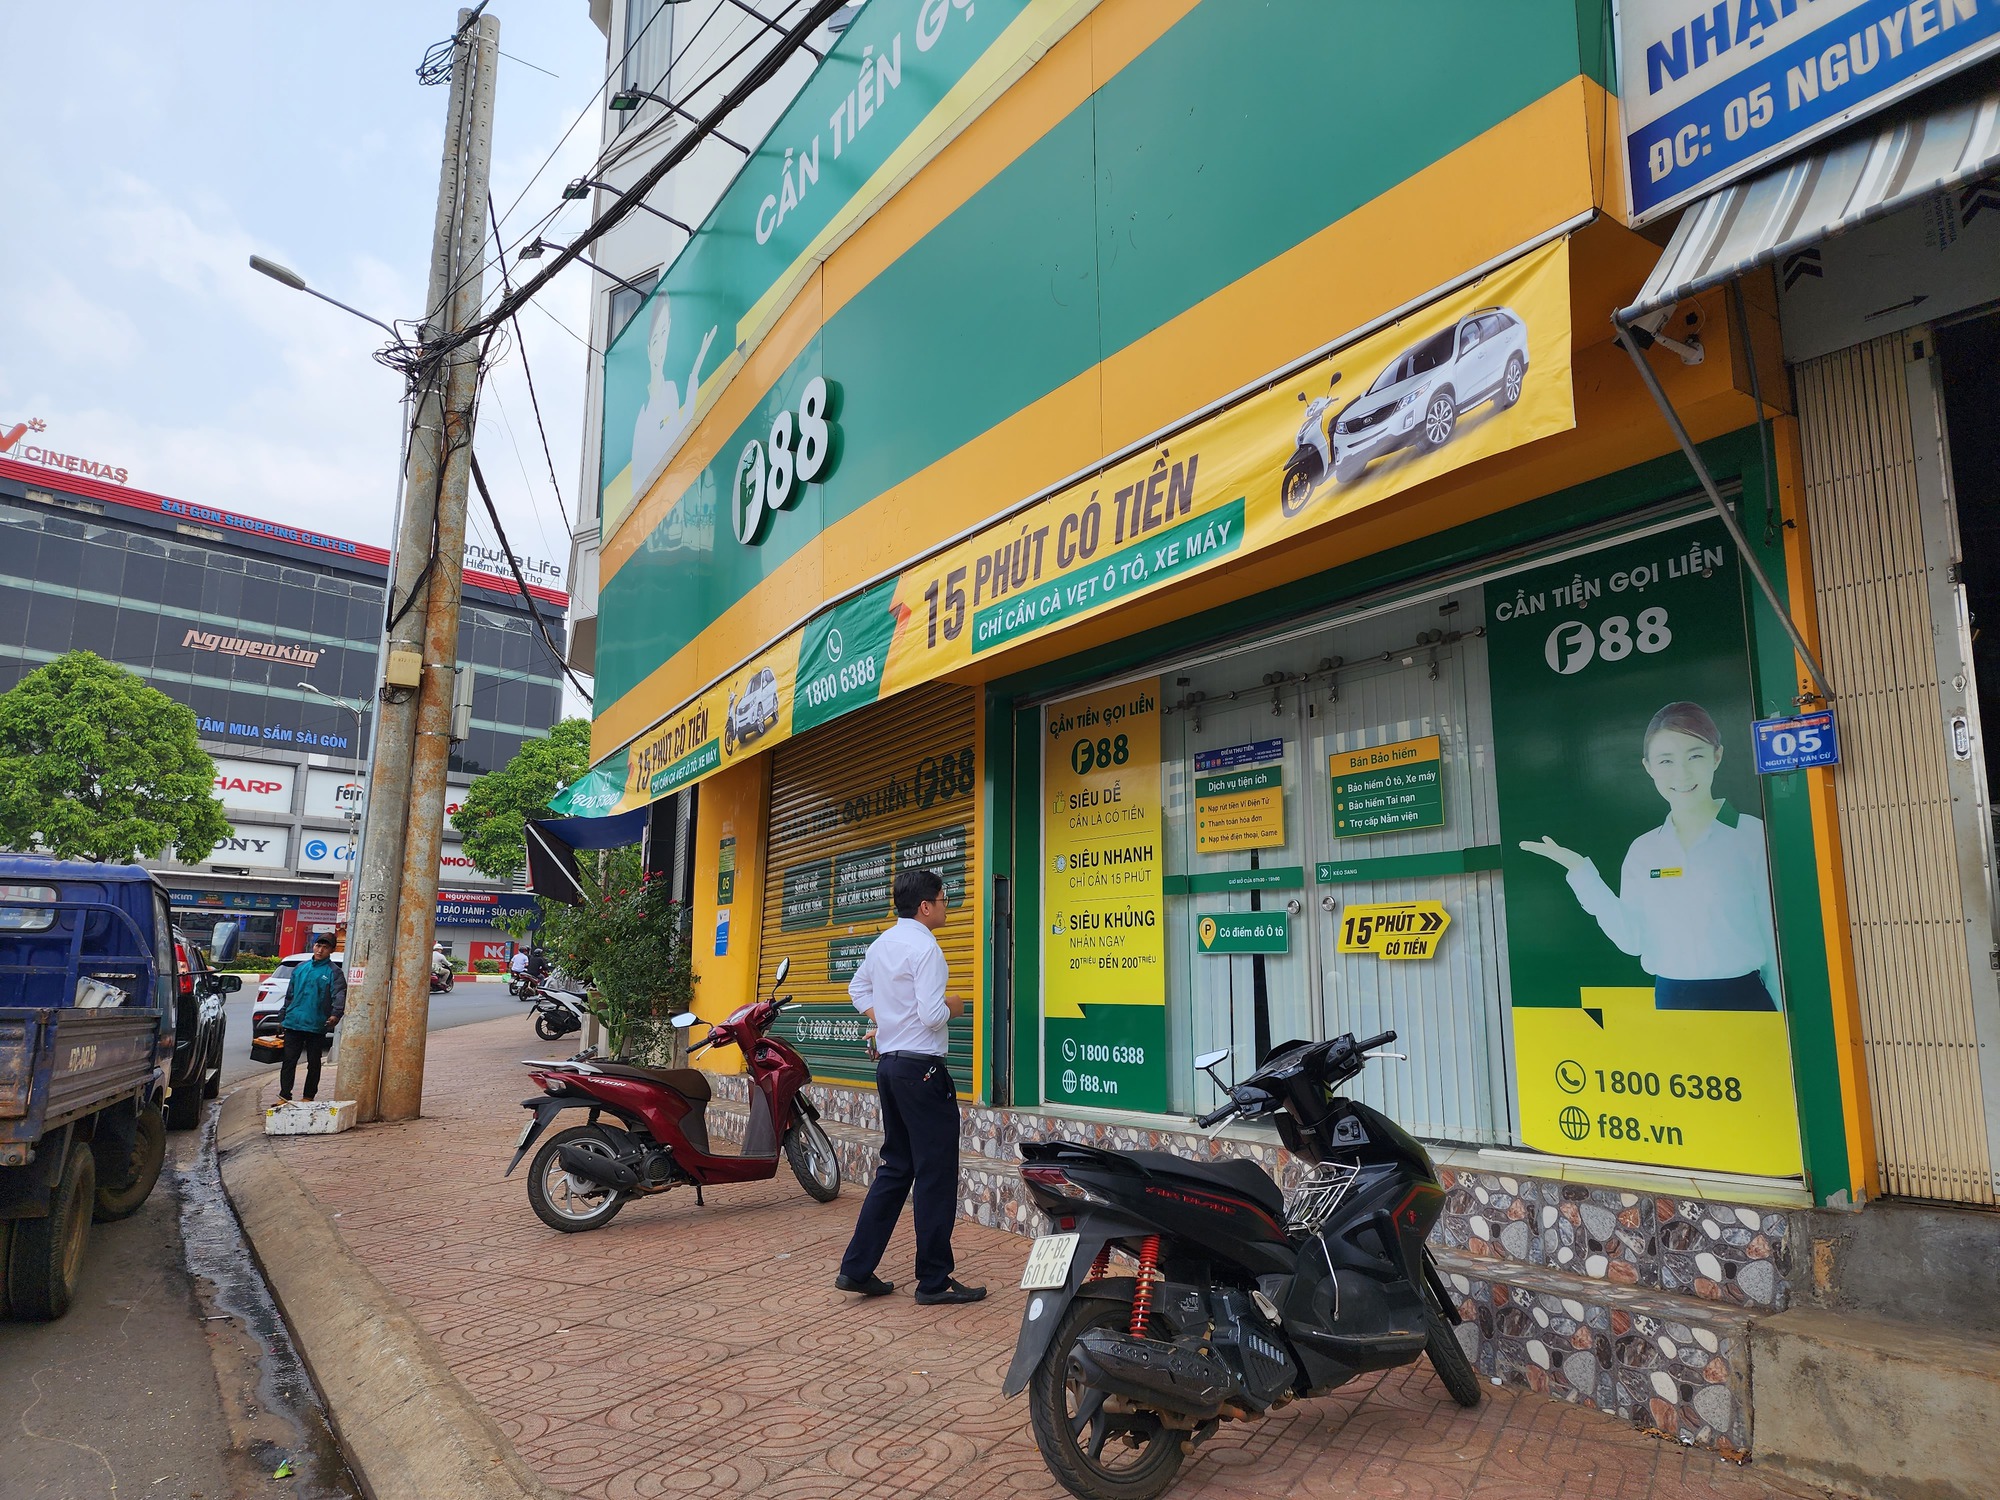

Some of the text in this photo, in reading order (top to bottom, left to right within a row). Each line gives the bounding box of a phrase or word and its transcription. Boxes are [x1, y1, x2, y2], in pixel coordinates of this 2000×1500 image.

[756, 32, 901, 245] CẦN TIỀN
[1649, 124, 1712, 184] ĐC:
[1723, 81, 1774, 141] 05
[24, 445, 129, 483] CINEMAS
[161, 499, 357, 554] SAI GON SHOPPING CENTER
[924, 565, 967, 649] 15
[973, 524, 1050, 607] PHÚT
[1056, 490, 1101, 569] CÓ
[1113, 449, 1199, 545] TIỀN
[527, 556, 561, 577] Life
[979, 520, 1232, 641] CHỈ CẦN CÀ VẸT Ô TÔ, XE MÁY
[1495, 541, 1724, 622] CẦN TIỀN GỌI LIỀN
[1544, 606, 1672, 675] F88
[806, 655, 875, 708] 1800 6388
[1050, 692, 1154, 736] CẦN TIỀN GỌI LIỀN
[229, 723, 259, 738] MUA
[263, 724, 292, 741] SẮM
[296, 729, 317, 745] SÀI
[320, 733, 347, 749] GÒN
[636, 701, 709, 793] 15 PHÚT CÓ TIỀN
[1772, 729, 1822, 756] 05
[1071, 734, 1130, 775] F88
[1350, 747, 1417, 768] Bán Bảo hiểm
[1208, 773, 1268, 792] Dịch vụ tiện ích
[1348, 770, 1436, 793] Bảo hiểm Ô tô, Xe máy
[1069, 780, 1121, 810] SIÊU DỄ
[1348, 794, 1415, 811] Bảo hiểm Tai nạn
[1069, 803, 1145, 829] CẦN LÀ CÓ TIỀN
[1207, 805, 1218, 814] Nạp
[1350, 811, 1418, 829] Trợ cấp Nằm viện
[1208, 820, 1225, 828] Thanh
[1226, 817, 1239, 826] toán
[1208, 835, 1219, 844] Nạp
[1230, 832, 1243, 841] điện
[1260, 830, 1278, 838] Game
[1070, 845, 1153, 869] SIÊU NHANH
[1070, 868, 1152, 888] CHỈ CẦN 15 PHÚT
[443, 903, 507, 916] BẢO HÀNH SỬA
[1070, 905, 1155, 931] SIÊU KHỦNG
[1204, 924, 1211, 935] P
[1220, 928, 1230, 938] Có
[1232, 926, 1252, 938] điểm
[1266, 924, 1273, 937] Ô
[1275, 925, 1284, 937] tô
[1345, 911, 1415, 945] 15 PHÚT
[484, 945, 503, 958] NK
[1069, 934, 1126, 950] NHẬN NGAY
[1386, 937, 1428, 956] CÓ TIỀN
[1098, 953, 1119, 969] ĐẾN
[1080, 1044, 1144, 1064] 1800 6388
[588, 1077, 626, 1088] VISION
[1079, 1073, 1118, 1094] f88.vn
[1595, 1069, 1742, 1102] 1800 6388
[1597, 1113, 1684, 1146] f88.vn
[1036, 1237, 1071, 1261] 47-B2
[1023, 1261, 1067, 1286] 601.46
